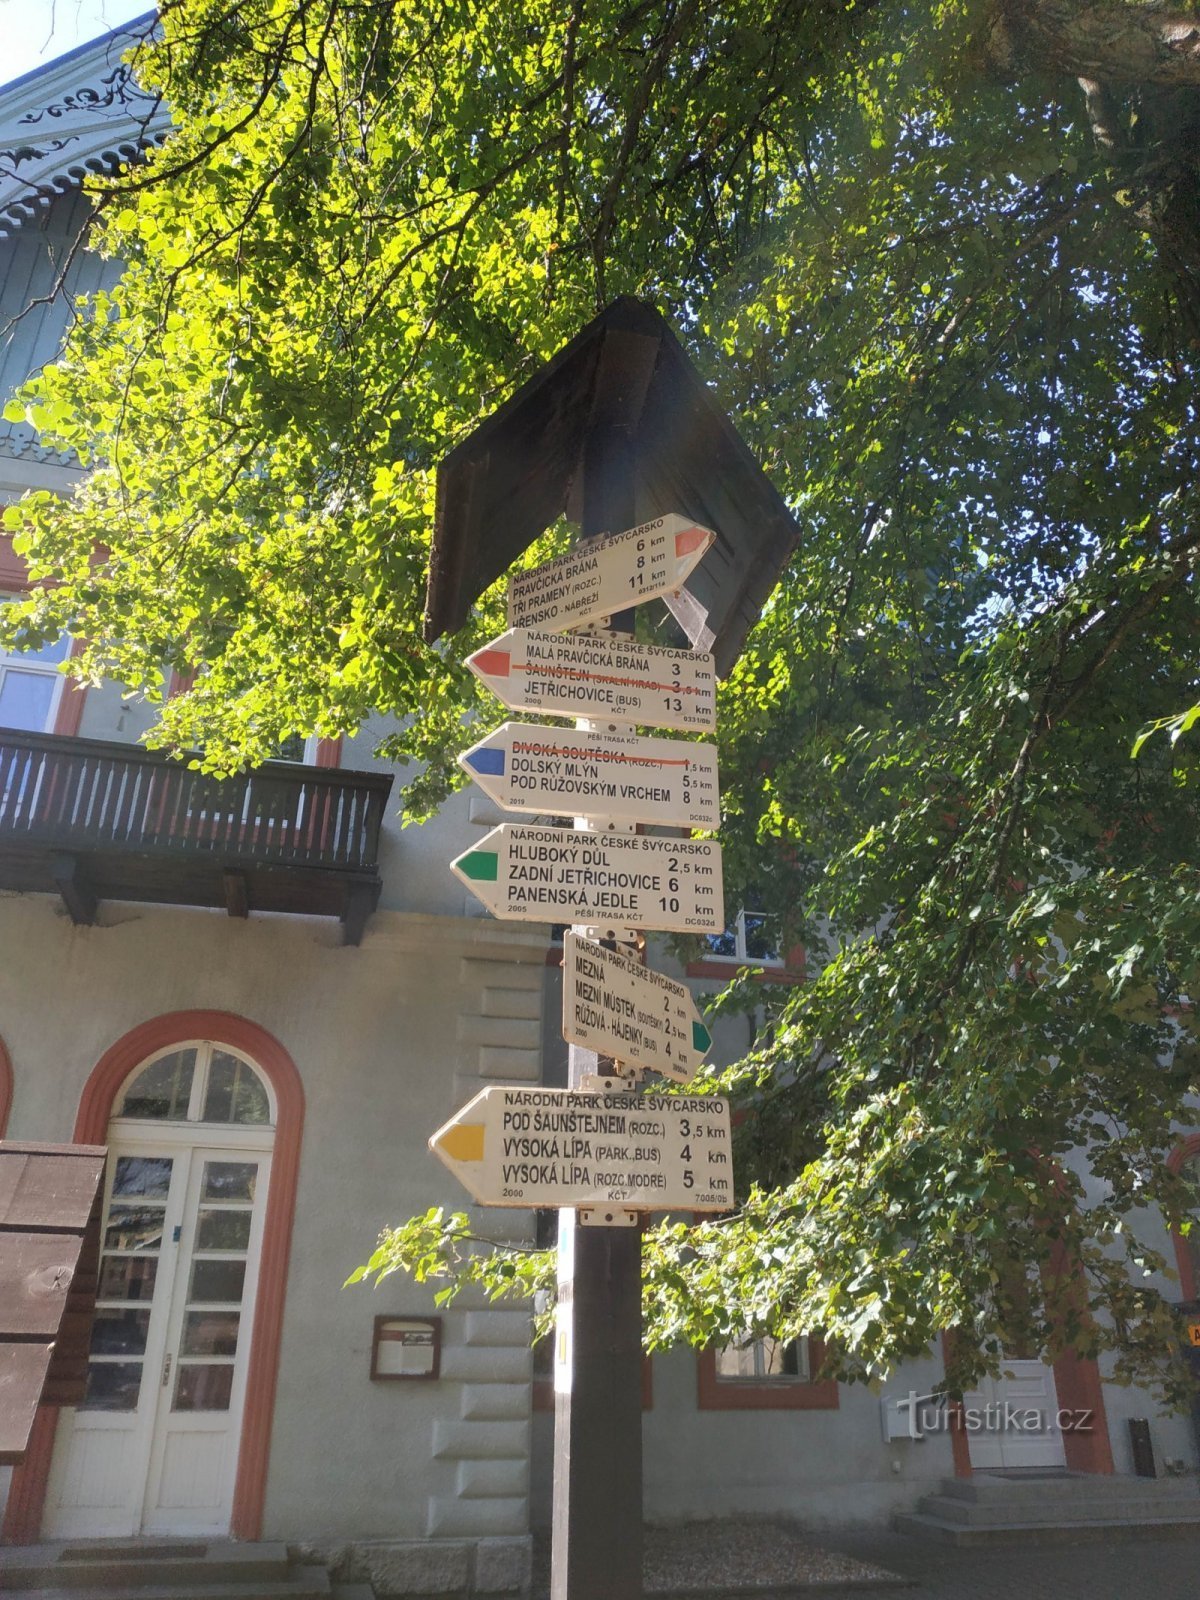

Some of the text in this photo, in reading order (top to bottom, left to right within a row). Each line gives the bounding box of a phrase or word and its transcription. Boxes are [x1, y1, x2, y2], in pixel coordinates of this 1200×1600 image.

[513, 536, 665, 600] PRAVČICKÁ BRÁNA 6 km
[552, 555, 575, 569] PARK
[512, 553, 666, 615] TŘI PRAMENY (ROZC.) 8 km
[512, 605, 558, 628] HŘENSKO
[564, 591, 599, 613] NÁBŘEŽÍ
[628, 572, 643, 588] 11
[651, 570, 666, 581] km
[579, 607, 592, 616] KČT
[527, 631, 710, 663] NÁRODNÍ PARK ČESKÉ ŠVÝCARSKO
[526, 645, 711, 680] MALÁ PRAVČICKÁ BRÁNA 3 km
[525, 660, 590, 682] ŠAUNŠTEJN
[671, 681, 692, 695] 3,5
[695, 687, 711, 698] km
[524, 681, 712, 715] JETŘICHOVICE (BUS) 13 km
[524, 697, 542, 705] 2000
[610, 706, 626, 715] KČT
[587, 733, 639, 745] PĚŠÍ TRASA KČT
[512, 741, 559, 758] DIVOKÁ
[562, 746, 627, 764] SOUTĚSKA
[699, 765, 712, 773] km
[511, 758, 713, 790] DOLSKÝ MLÝN 5,5 km
[509, 798, 525, 806] 2019
[511, 775, 713, 806] POD RŮŽOVSKÝM VRCHEM 8 km
[510, 829, 712, 856] NÁRODNÍ PARK ČESKÉ ŠVÝCARSKO
[509, 845, 713, 875] HLUBOKÝ DŮL 2,5 km
[508, 865, 713, 895] ZADNÍ JETŘICHOVICE 6 km
[508, 885, 714, 915] PANENSKÁ JEDLE 10 km
[508, 905, 527, 913] 2005
[575, 909, 643, 921] PĚŠÍ TRASA KČT
[685, 918, 715, 927] DC032d
[575, 937, 608, 961] NÁRODNÍ
[608, 953, 626, 971] PARK
[575, 955, 687, 1020] MEZNÁ 2 km
[575, 979, 602, 1006] MEZNÍ
[664, 1018, 677, 1037] 2,5
[677, 1028, 687, 1041] km
[575, 1002, 606, 1032] RŮŽOVÁ
[611, 1017, 643, 1045] HÁJENKY
[643, 1036, 658, 1054] (BUS)
[665, 1041, 671, 1057] 4
[678, 1050, 688, 1064] km
[504, 1091, 724, 1114] NÁRODNÍ PARK ČESKÉ ŠVÝCARSKO
[503, 1110, 726, 1139] POD ŠAUNŠTEJNEM (ROZC.) 3,5 km
[503, 1137, 559, 1157] VYSOKÁ
[563, 1140, 592, 1159] LÍPA
[680, 1145, 692, 1162] 4
[708, 1151, 727, 1164] km
[502, 1162, 559, 1184] VYSOKÁ
[562, 1164, 591, 1186] LÍPA
[683, 1170, 694, 1188] 5
[709, 1177, 728, 1190] km
[502, 1188, 523, 1198] 2000
[608, 1190, 628, 1201] KČT
[695, 1193, 727, 1203] 7005/0b
